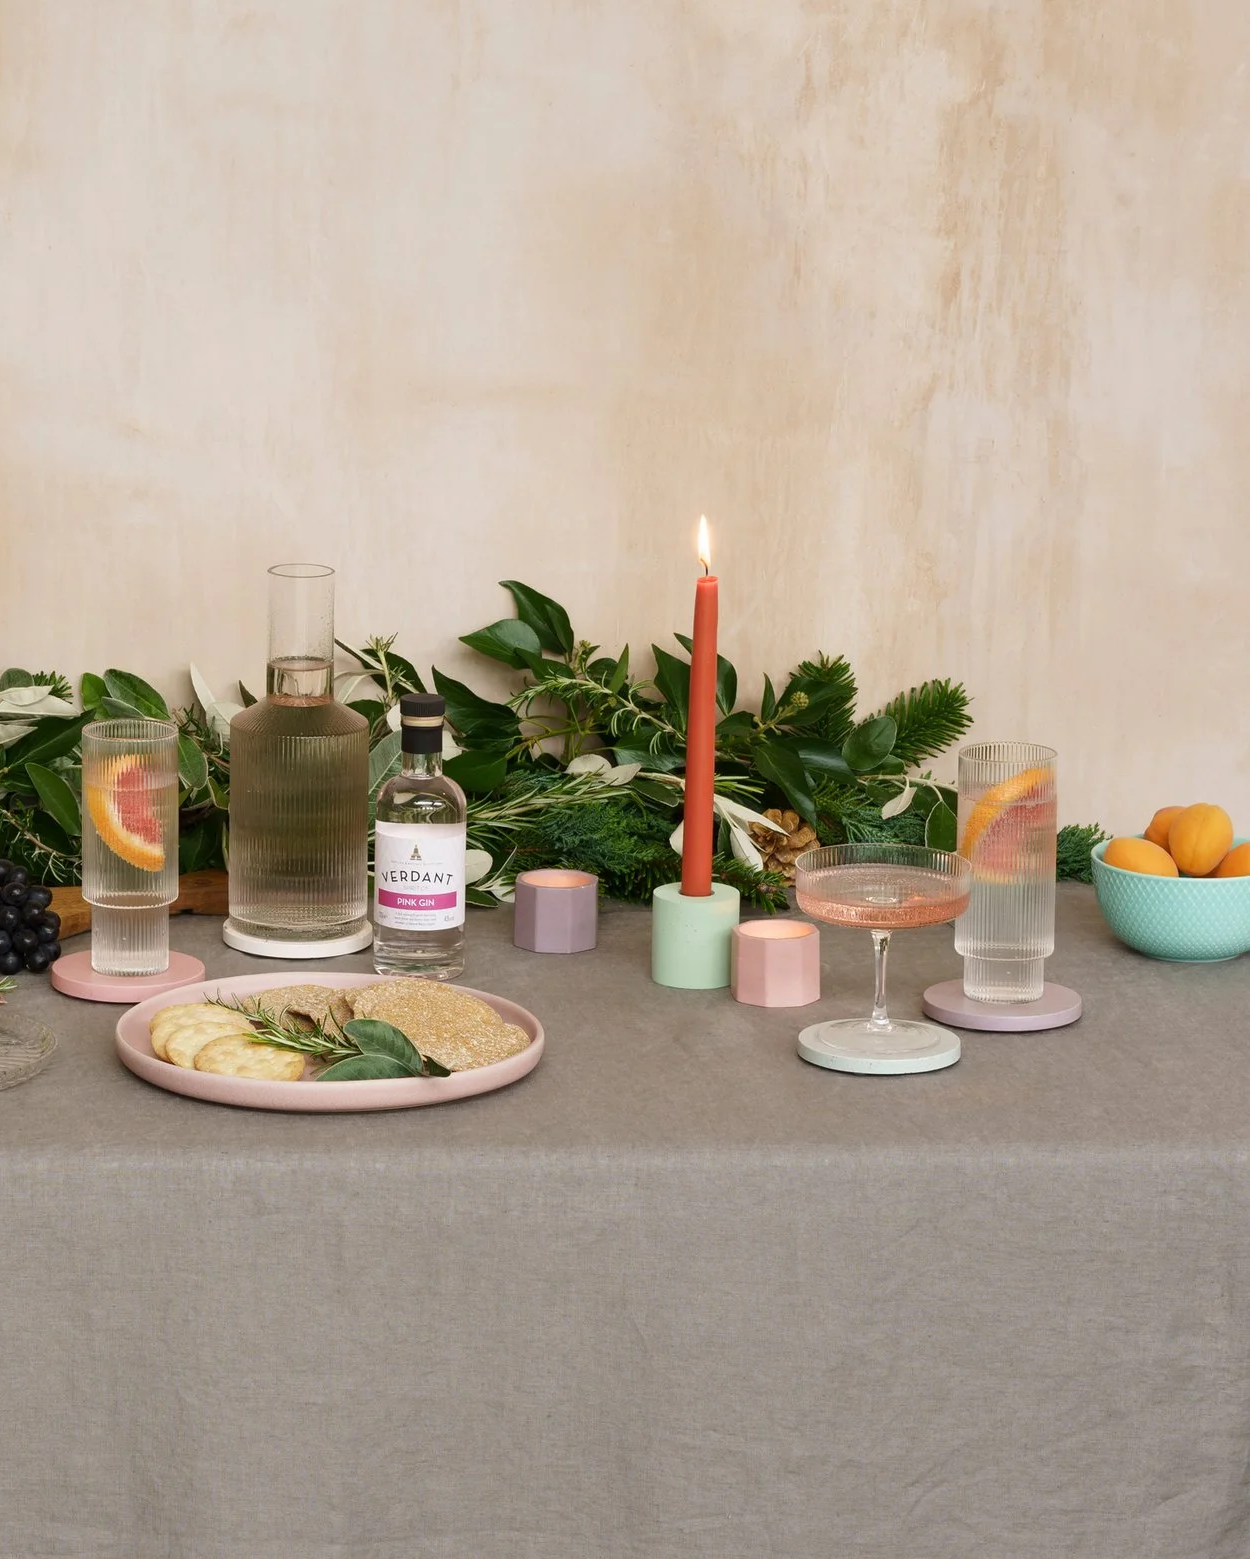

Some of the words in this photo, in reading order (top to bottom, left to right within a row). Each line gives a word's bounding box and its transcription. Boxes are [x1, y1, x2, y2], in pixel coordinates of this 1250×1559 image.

[382, 871, 453, 885] VERDANT
[397, 898, 417, 906] PINK
[419, 899, 435, 907] GIN
